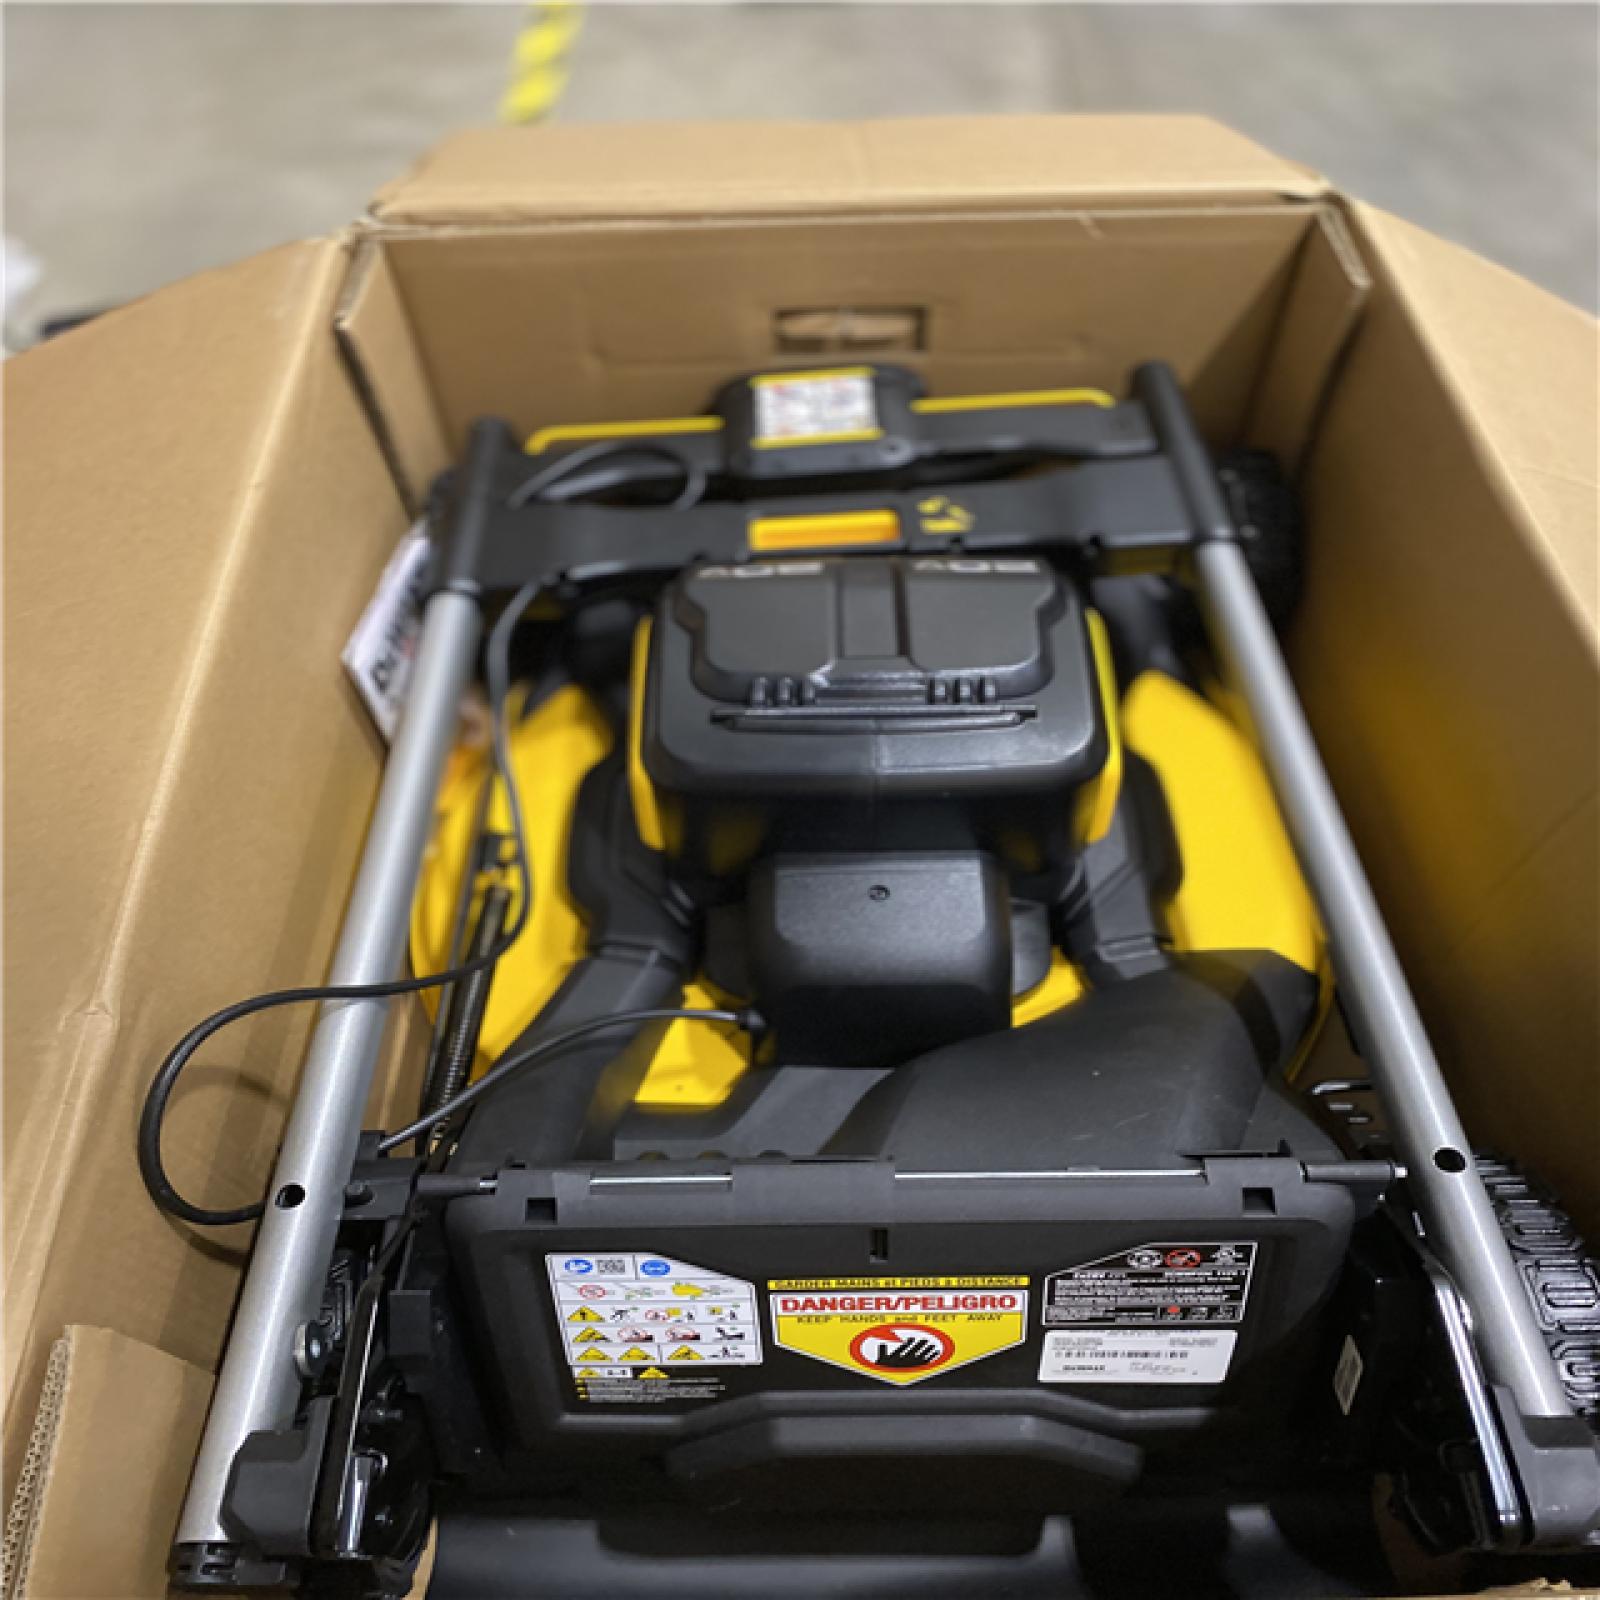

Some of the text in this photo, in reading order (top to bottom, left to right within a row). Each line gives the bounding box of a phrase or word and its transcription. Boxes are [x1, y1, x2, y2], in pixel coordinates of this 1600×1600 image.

[837, 1278, 879, 1288] MAINS
[900, 1277, 939, 1288] PIEDS
[958, 1275, 1019, 1287] DISTANCE
[781, 1294, 1017, 1312] DANGER/PELIGRO
[796, 1313, 1003, 1323] KEEP HANDS and FEET AWAY
